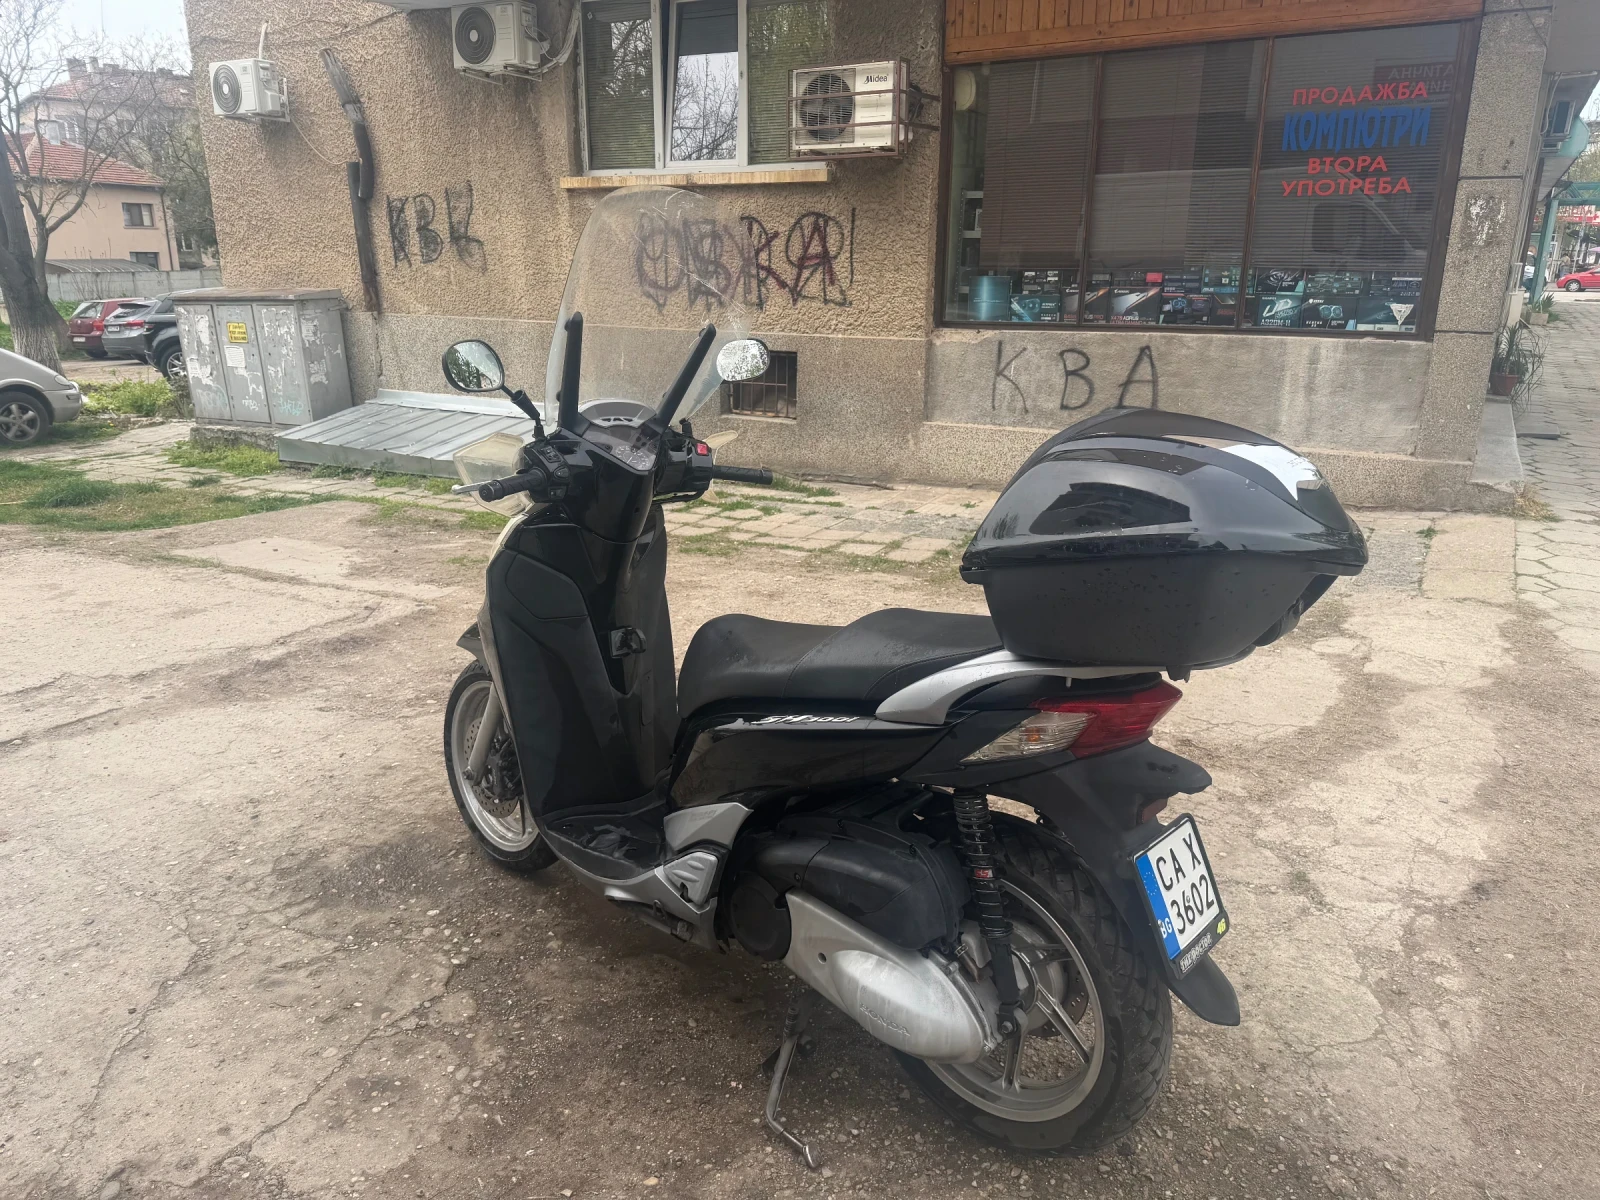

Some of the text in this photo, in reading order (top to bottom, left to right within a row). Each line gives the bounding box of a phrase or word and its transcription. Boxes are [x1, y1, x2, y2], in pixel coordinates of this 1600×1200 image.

[863, 75, 888, 84] Midea
[1292, 81, 1428, 106] ПРОДАЖБА
[1282, 105, 1432, 154] КОМПЮТРИ
[1307, 155, 1388, 175] ВТОРА
[1282, 177, 1412, 197] УПОТРЕБА
[1155, 832, 1202, 892] CA X
[1170, 873, 1215, 935] 3602
[1160, 917, 1173, 939] BG
